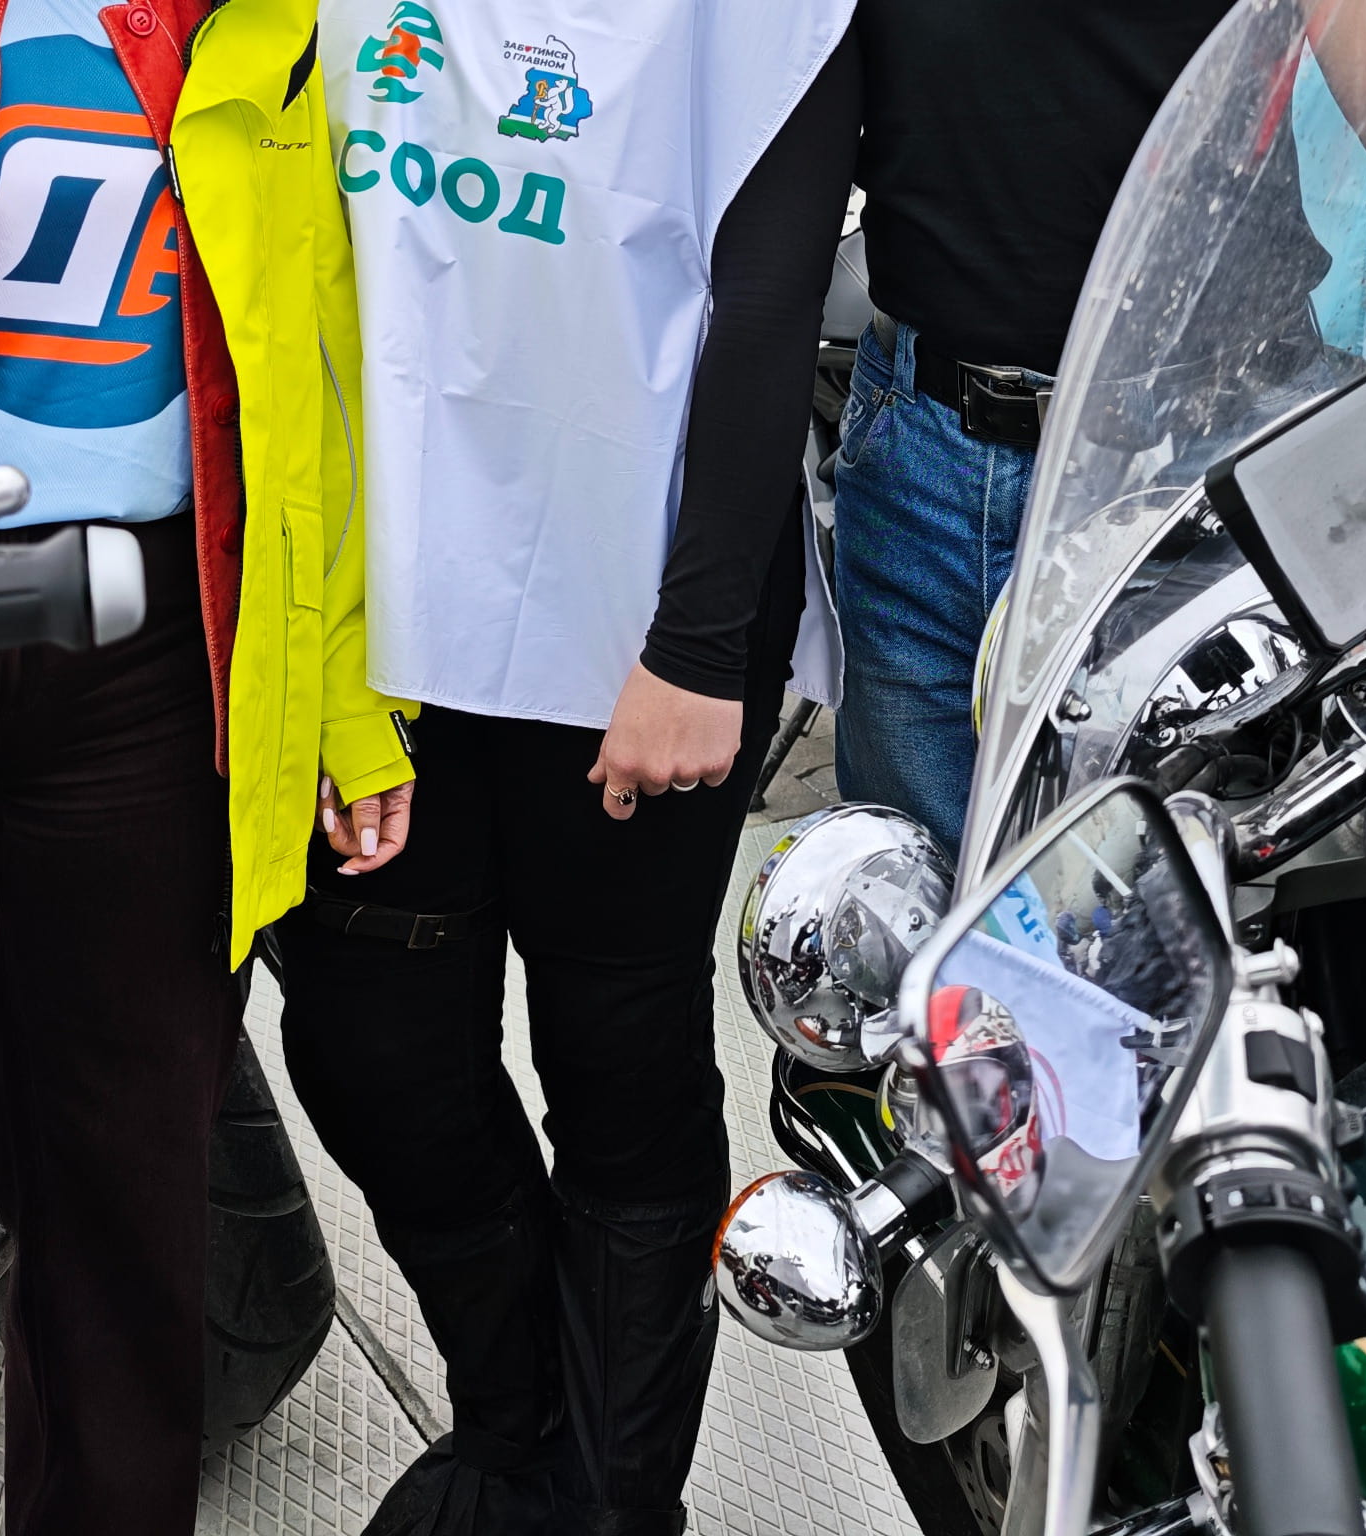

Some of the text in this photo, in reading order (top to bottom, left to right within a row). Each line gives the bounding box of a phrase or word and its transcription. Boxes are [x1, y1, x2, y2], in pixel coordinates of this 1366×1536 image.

[503, 51, 565, 70] О ГЛАВНОМ
[338, 129, 566, 245] СООД
